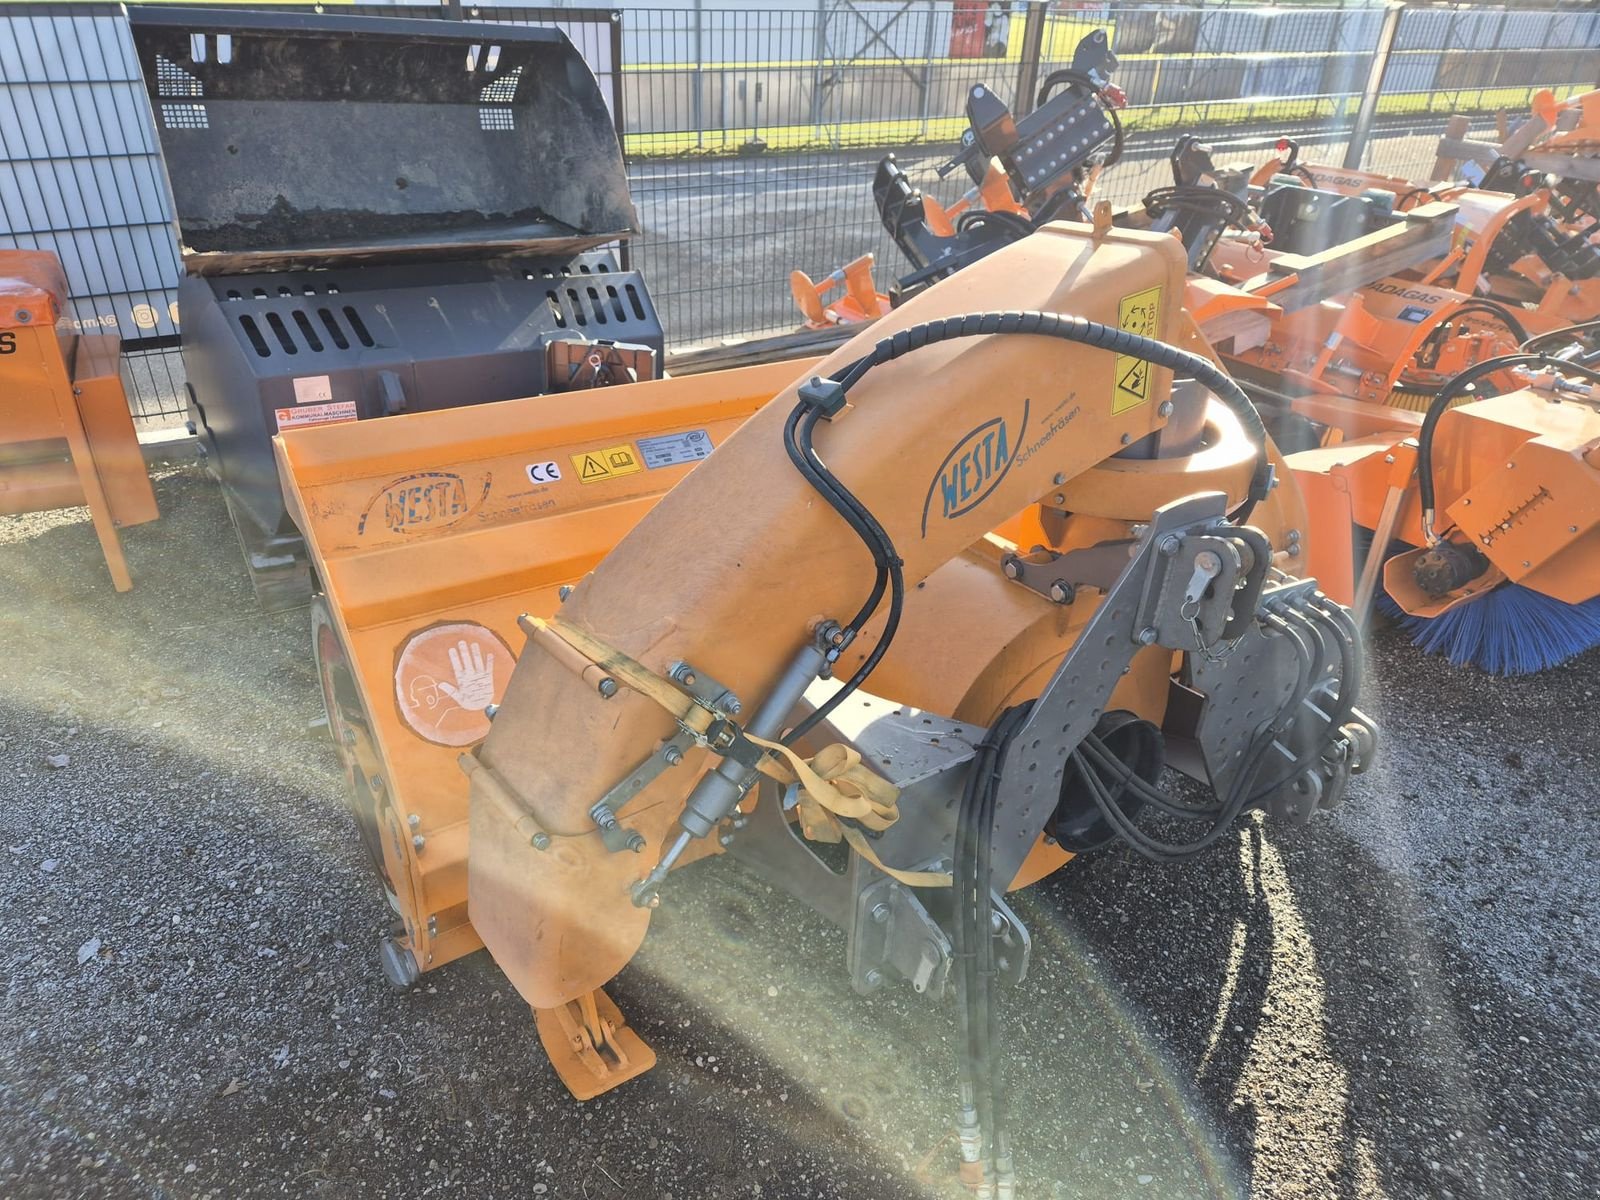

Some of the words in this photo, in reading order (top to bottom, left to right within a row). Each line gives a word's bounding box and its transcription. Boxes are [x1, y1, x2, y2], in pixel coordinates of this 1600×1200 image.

[1147, 303, 1156, 336] STOP
[327, 403, 355, 411] STEFAN
[1015, 405, 1081, 467] Schneefräsen
[530, 462, 560, 482] CE
[941, 421, 1009, 517] WESTA
[385, 479, 468, 528] WESTA
